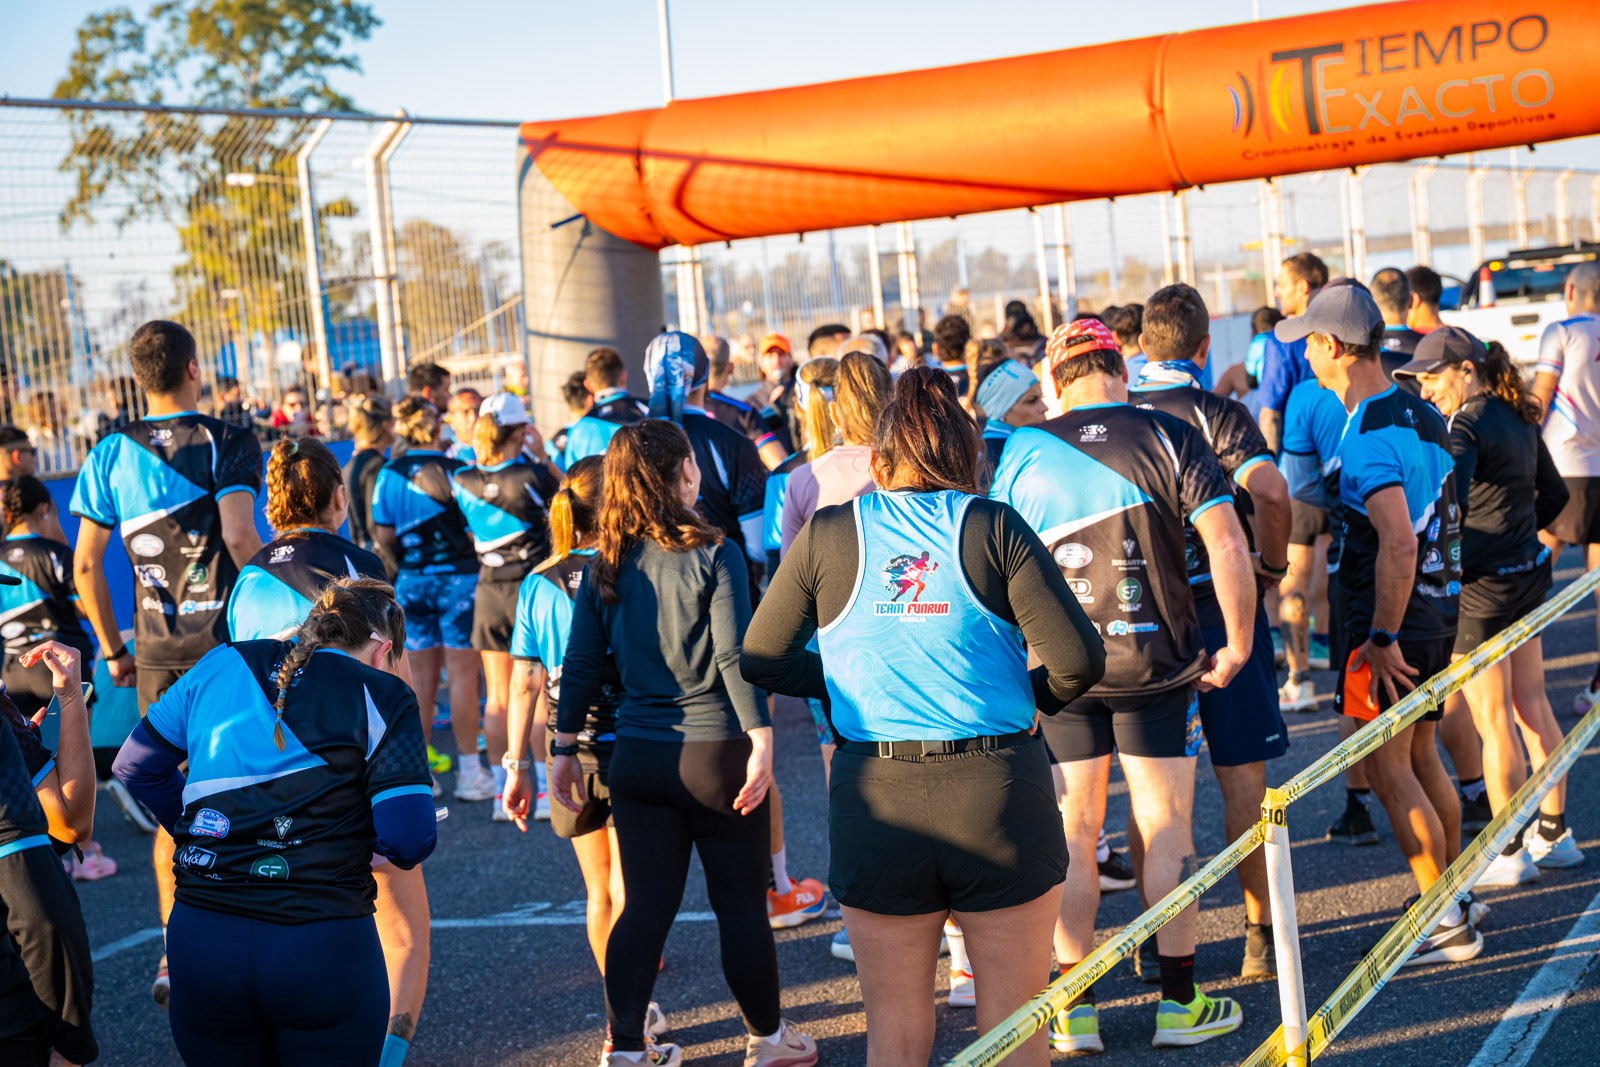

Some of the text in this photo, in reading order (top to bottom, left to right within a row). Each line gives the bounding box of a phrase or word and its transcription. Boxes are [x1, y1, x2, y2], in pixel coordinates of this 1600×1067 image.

[1271, 14, 1549, 135] TIEMPO
[1316, 57, 1554, 134] EXACTO
[1366, 135, 1386, 145] de
[1395, 126, 1459, 140] Eventos
[1467, 112, 1556, 131] Deportivos
[875, 603, 949, 614] TEAM FUNRUN
